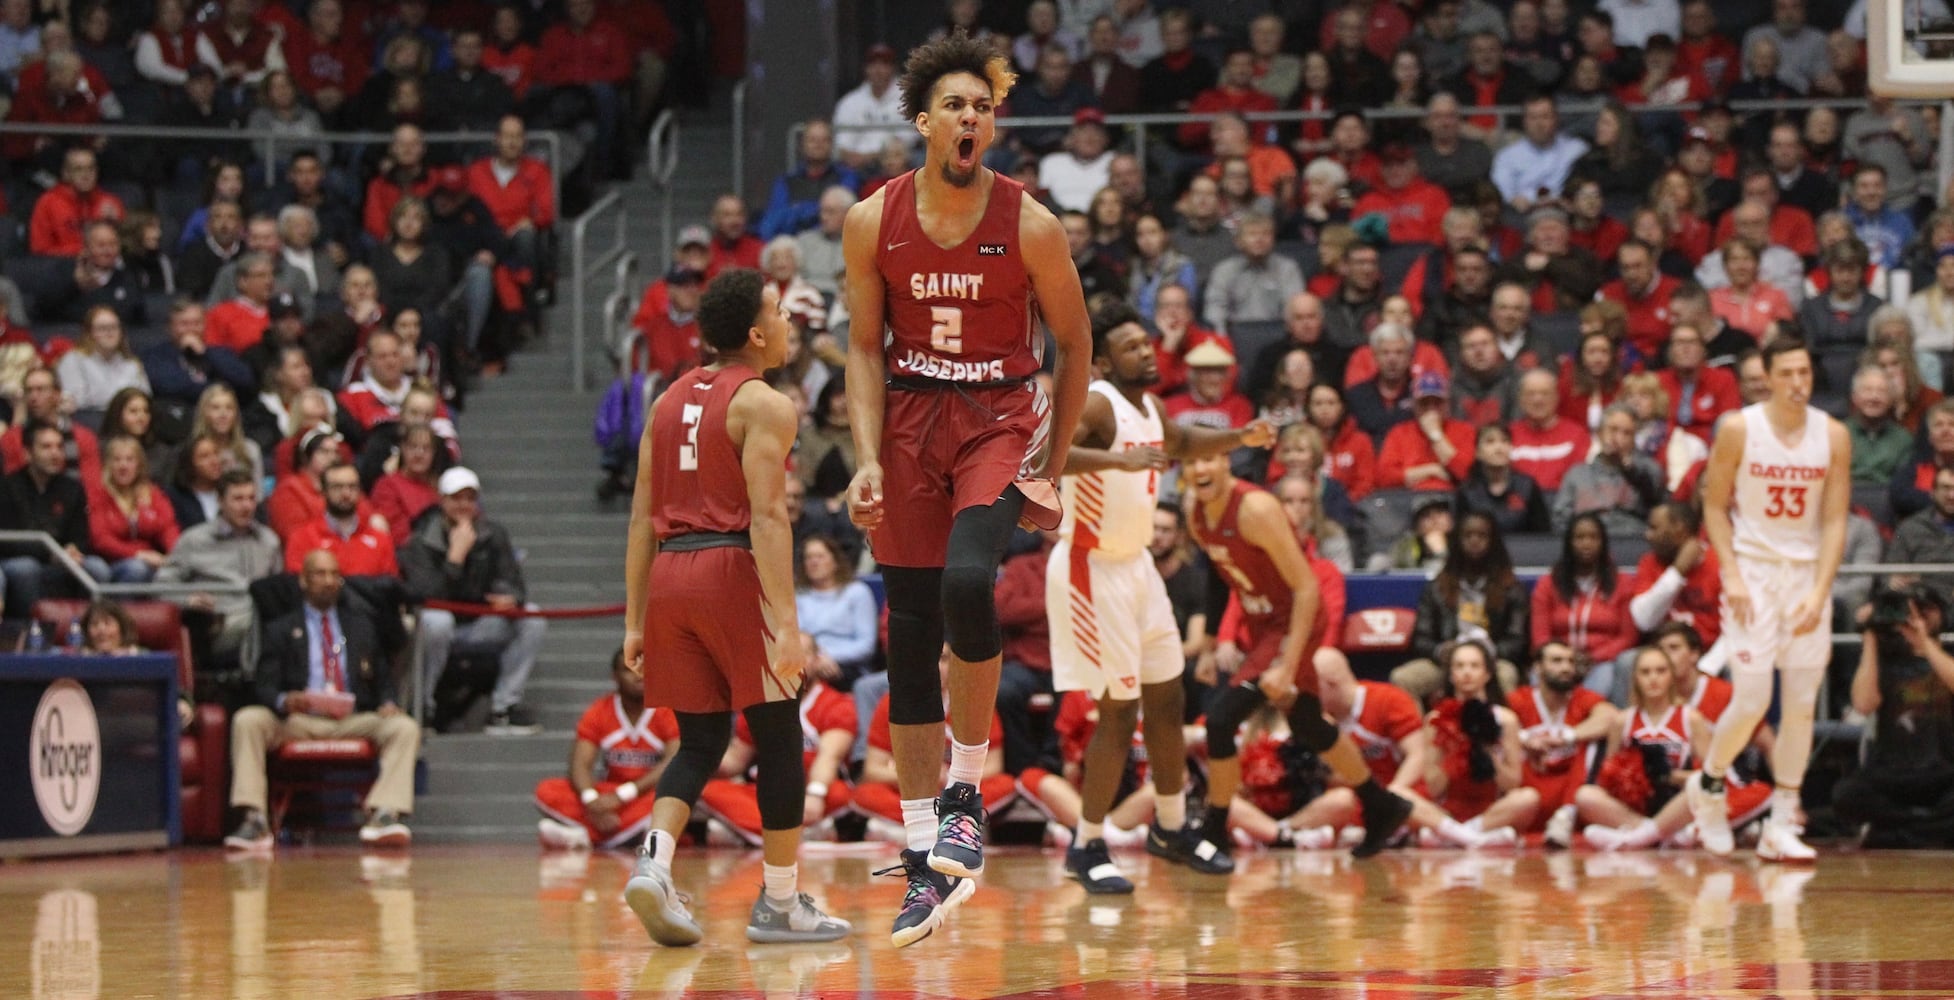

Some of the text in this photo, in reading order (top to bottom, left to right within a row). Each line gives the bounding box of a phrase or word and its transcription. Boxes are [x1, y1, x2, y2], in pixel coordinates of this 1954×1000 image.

[910, 273, 983, 300] SAINT
[930, 306, 963, 354] 2
[898, 349, 1004, 382] JOSEPH'S
[680, 403, 703, 471] 3
[1750, 463, 1825, 480] DAYTON
[1765, 486, 1808, 519] 33
[40, 706, 93, 812] Kroger
